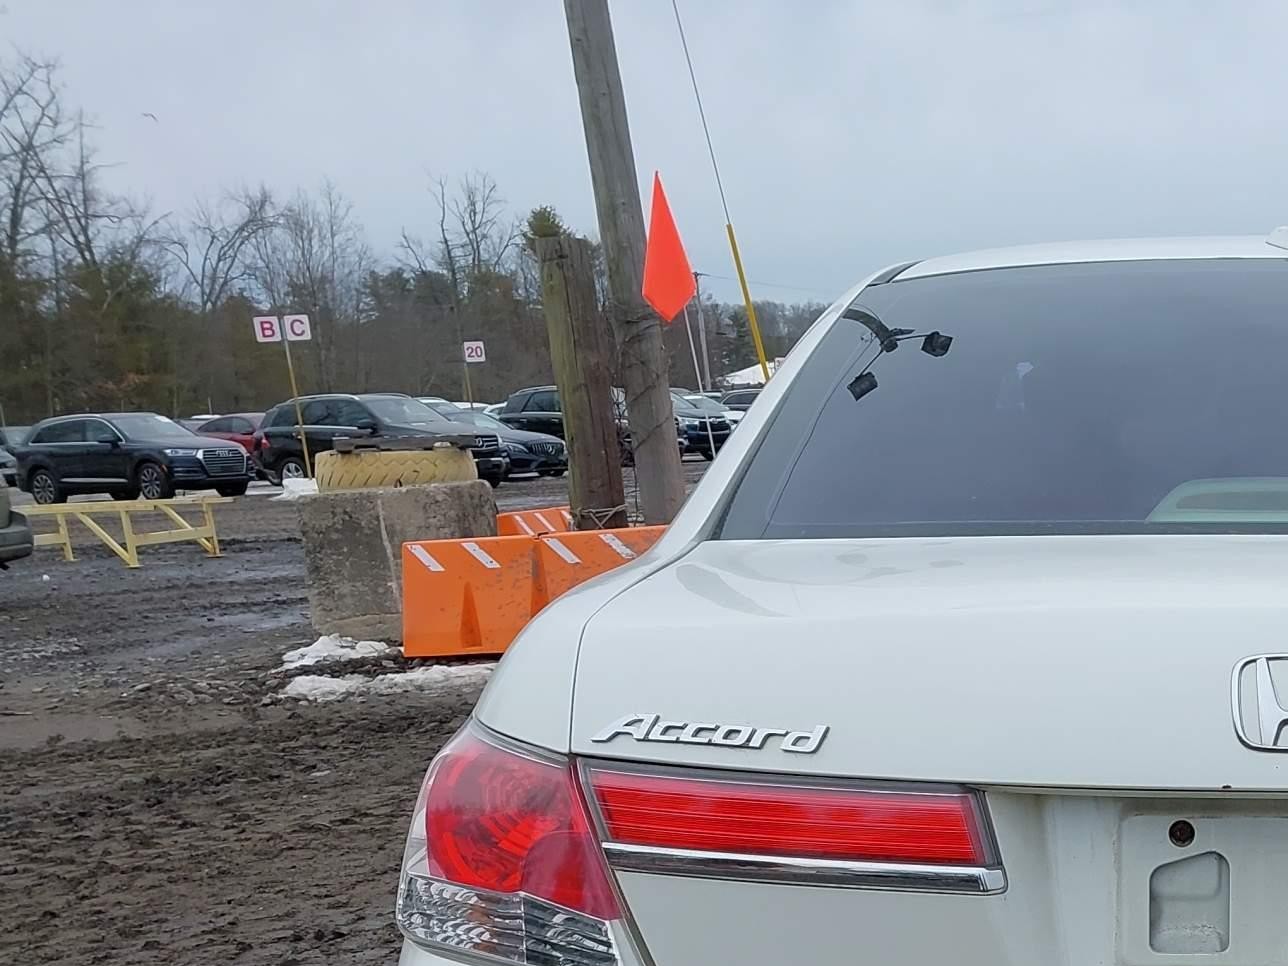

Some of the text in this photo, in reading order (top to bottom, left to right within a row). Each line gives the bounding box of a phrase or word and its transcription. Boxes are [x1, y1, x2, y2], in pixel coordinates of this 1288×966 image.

[260, 320, 276, 338] B
[290, 319, 306, 337] C
[466, 345, 483, 358] 20
[590, 713, 830, 754] Accord
